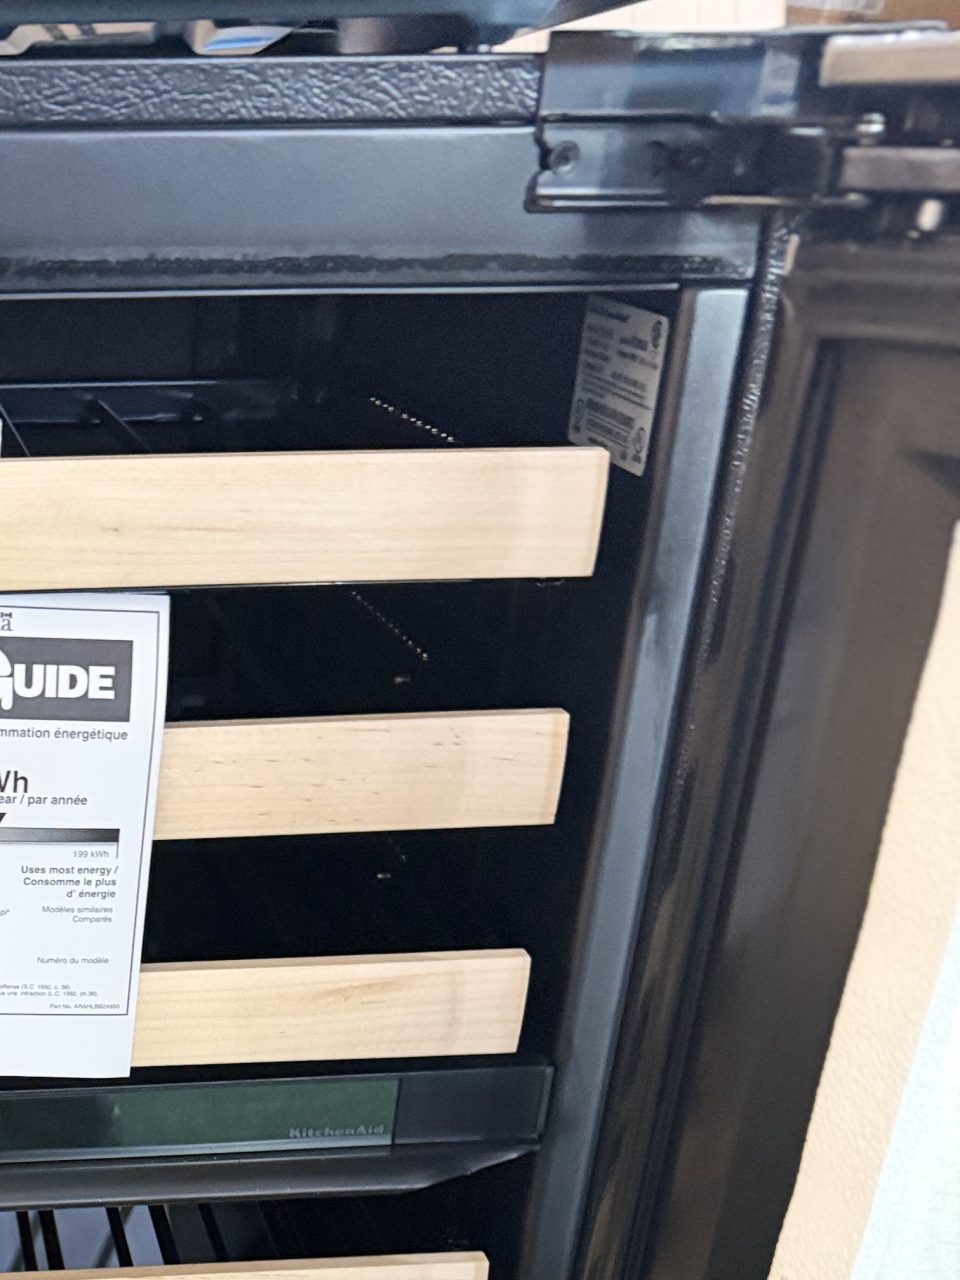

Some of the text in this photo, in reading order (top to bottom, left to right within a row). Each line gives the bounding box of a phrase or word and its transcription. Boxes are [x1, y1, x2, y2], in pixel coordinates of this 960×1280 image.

[54, 727, 129, 743] énergétique
[19, 794, 25, 805] /
[27, 796, 46, 807] par
[50, 796, 88, 806] année
[73, 850, 110, 858] 199 kWh
[21, 865, 46, 874] Uses
[49, 866, 75, 875] most
[77, 868, 112, 877] energy
[23, 877, 117, 888] Consomme le plus
[78, 890, 116, 900] énergie
[77, 906, 113, 914] similaires
[37, 956, 68, 964] Numéro
[288, 1125, 385, 1138] KitchenAid
